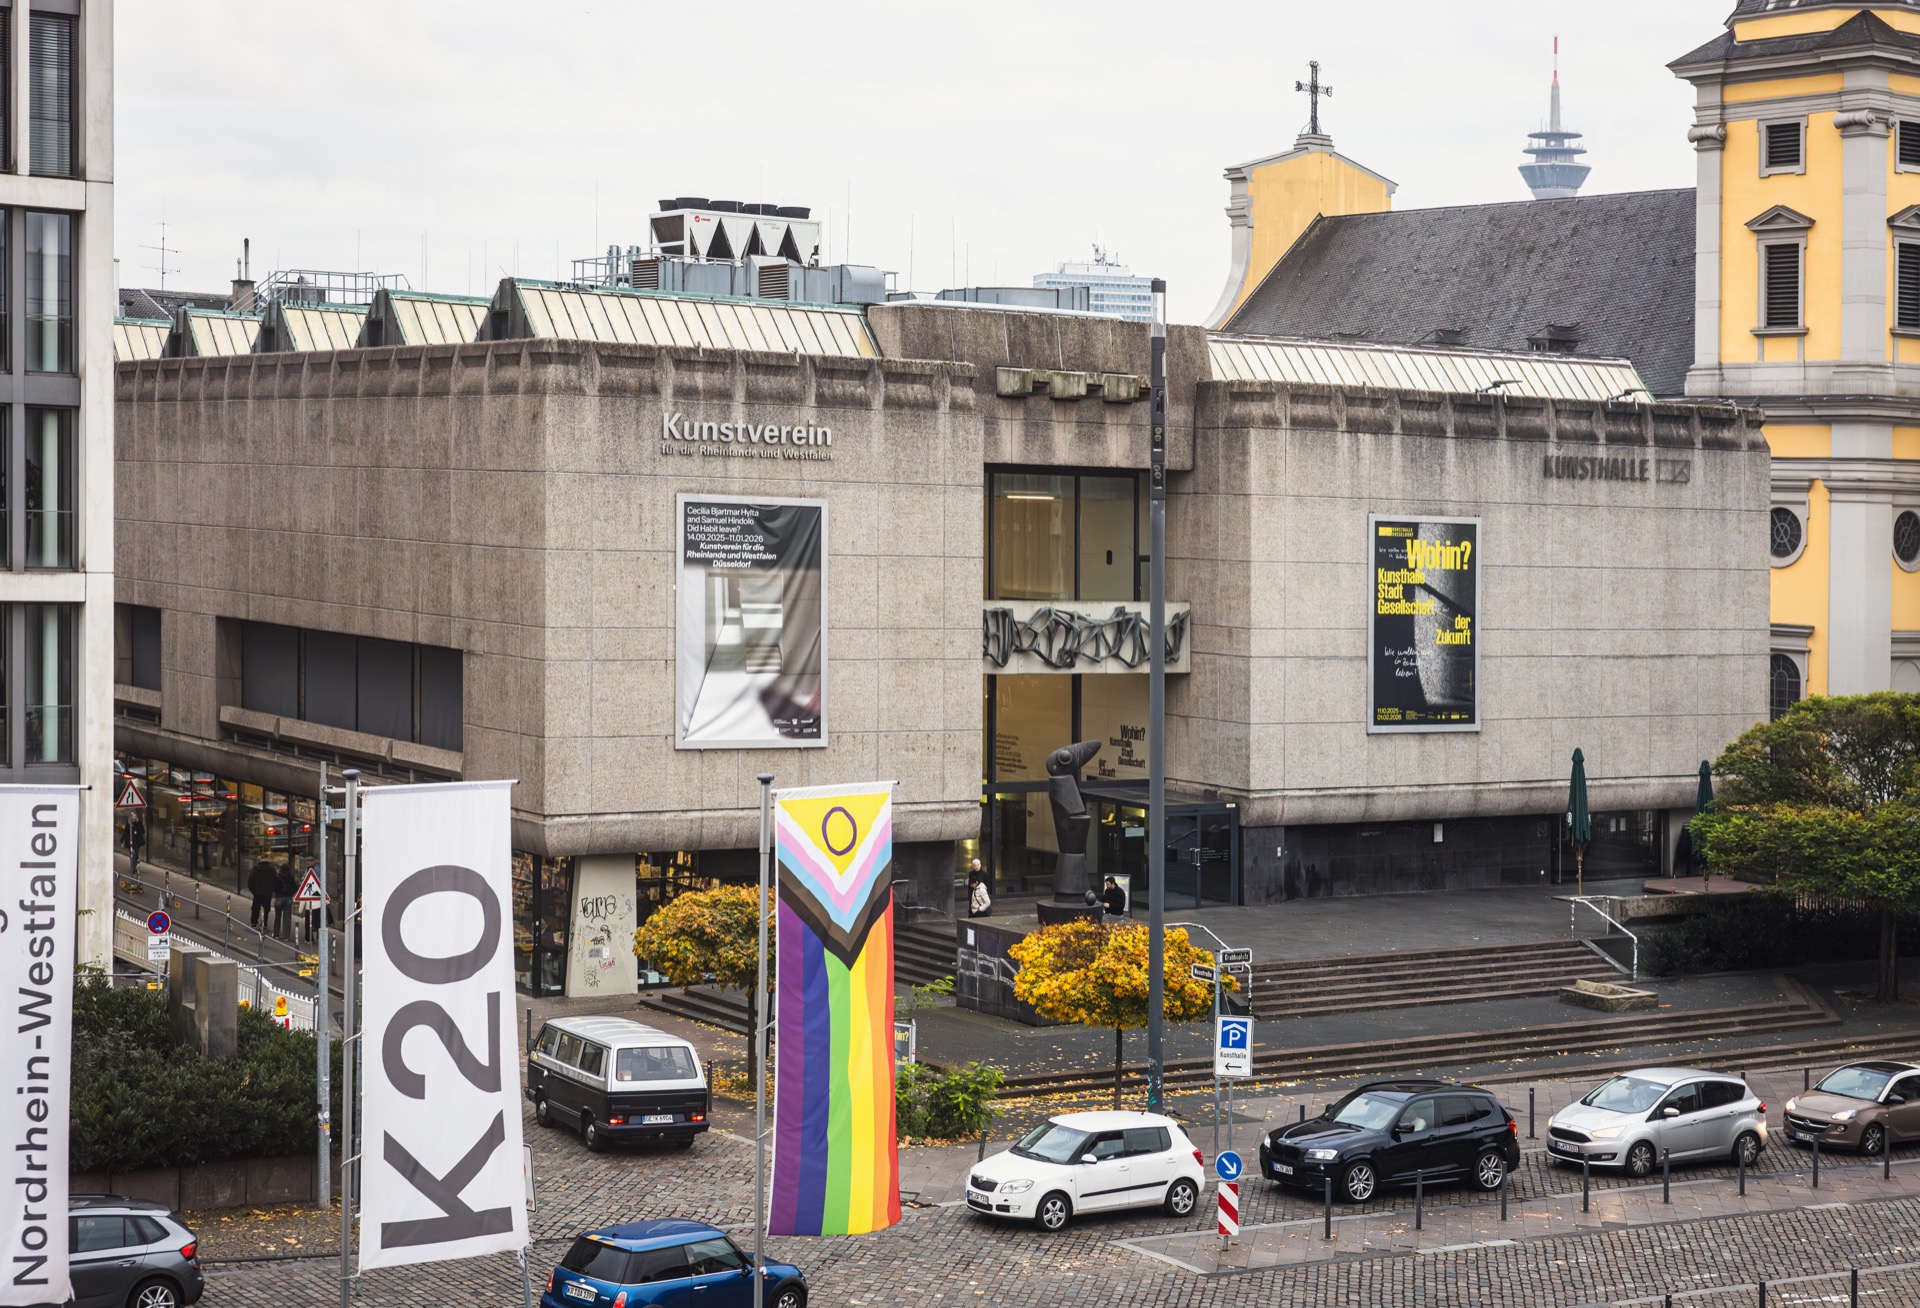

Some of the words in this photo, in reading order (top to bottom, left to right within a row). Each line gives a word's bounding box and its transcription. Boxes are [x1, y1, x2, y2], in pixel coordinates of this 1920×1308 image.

[662, 412, 833, 446] Kunstverein
[680, 444, 696, 456] die
[700, 446, 757, 457] Rheinlande
[760, 448, 780, 458] und
[783, 449, 833, 460] Westfalen
[1544, 455, 1649, 480] KUNSTHALLE
[687, 506, 710, 515] Cecilia
[711, 507, 740, 517] Bjartmar
[687, 515, 700, 524] and
[701, 516, 727, 524] Samuel
[728, 517, 754, 525] Hindolo
[687, 524, 699, 532] Did
[700, 525, 718, 533] Habit
[719, 525, 741, 533] leave?
[700, 542, 741, 551] Kunstverein
[742, 543, 752, 551] für
[753, 543, 764, 551] die
[1406, 539, 1471, 570] Wohin?
[686, 550, 726, 559] Rheinlande
[727, 551, 740, 559] und
[741, 552, 776, 560] Westfalen
[712, 560, 751, 568] Düsseldorf
[1377, 567, 1425, 584] Kunsthalle
[1377, 583, 1403, 599] Stadt
[1377, 599, 1435, 615] Gesellschaft
[1455, 614, 1471, 630] der
[1435, 628, 1471, 645] Zukunft
[1120, 724, 1145, 741] Wohin?
[1110, 736, 1132, 748] Kunsthalle
[1118, 756, 1145, 768] Gesellschaft
[13, 804, 58, 1286] Nordrhein-Westfalen
[381, 865, 514, 1250] K20
[1220, 1051, 1247, 1059] Kunsthalle
